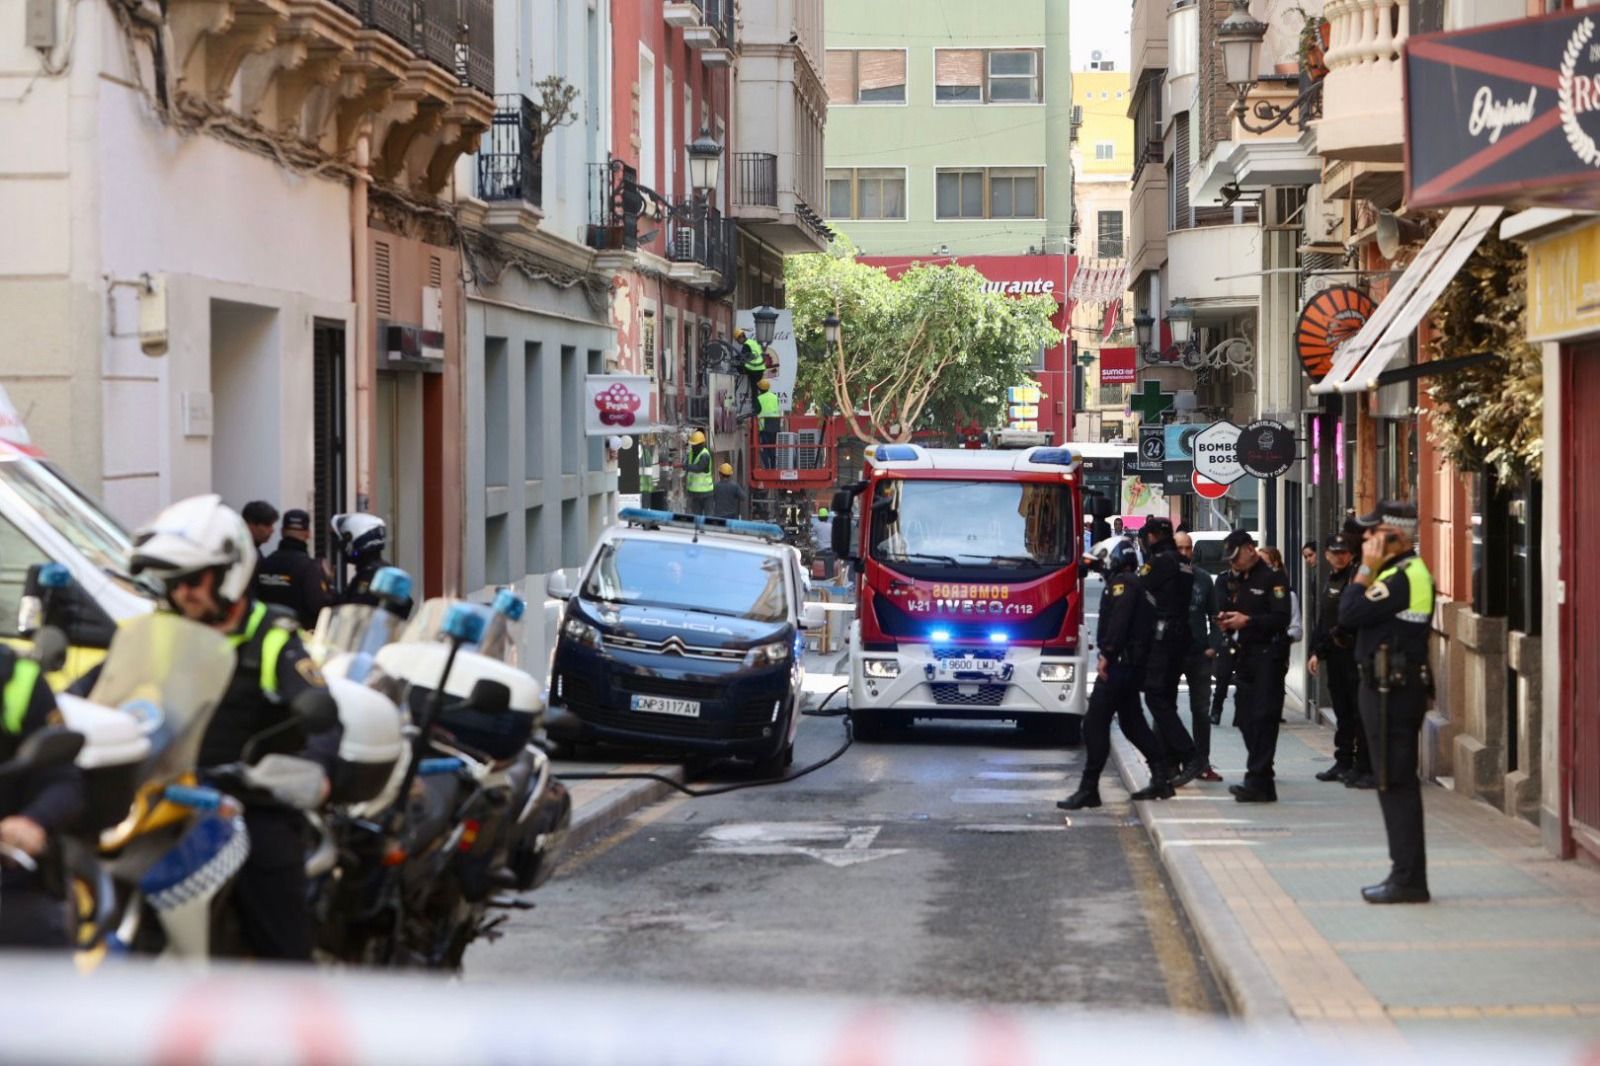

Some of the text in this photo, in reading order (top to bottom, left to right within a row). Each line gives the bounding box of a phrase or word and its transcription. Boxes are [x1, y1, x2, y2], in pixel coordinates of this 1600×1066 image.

[980, 277, 1054, 294] urante
[1147, 442, 1160, 457] 24
[1199, 443, 1239, 452] BOMBO
[1209, 455, 1239, 464] BOSS
[908, 600, 1033, 614] V-21 IVECO 112
[949, 660, 972, 670] 9600
